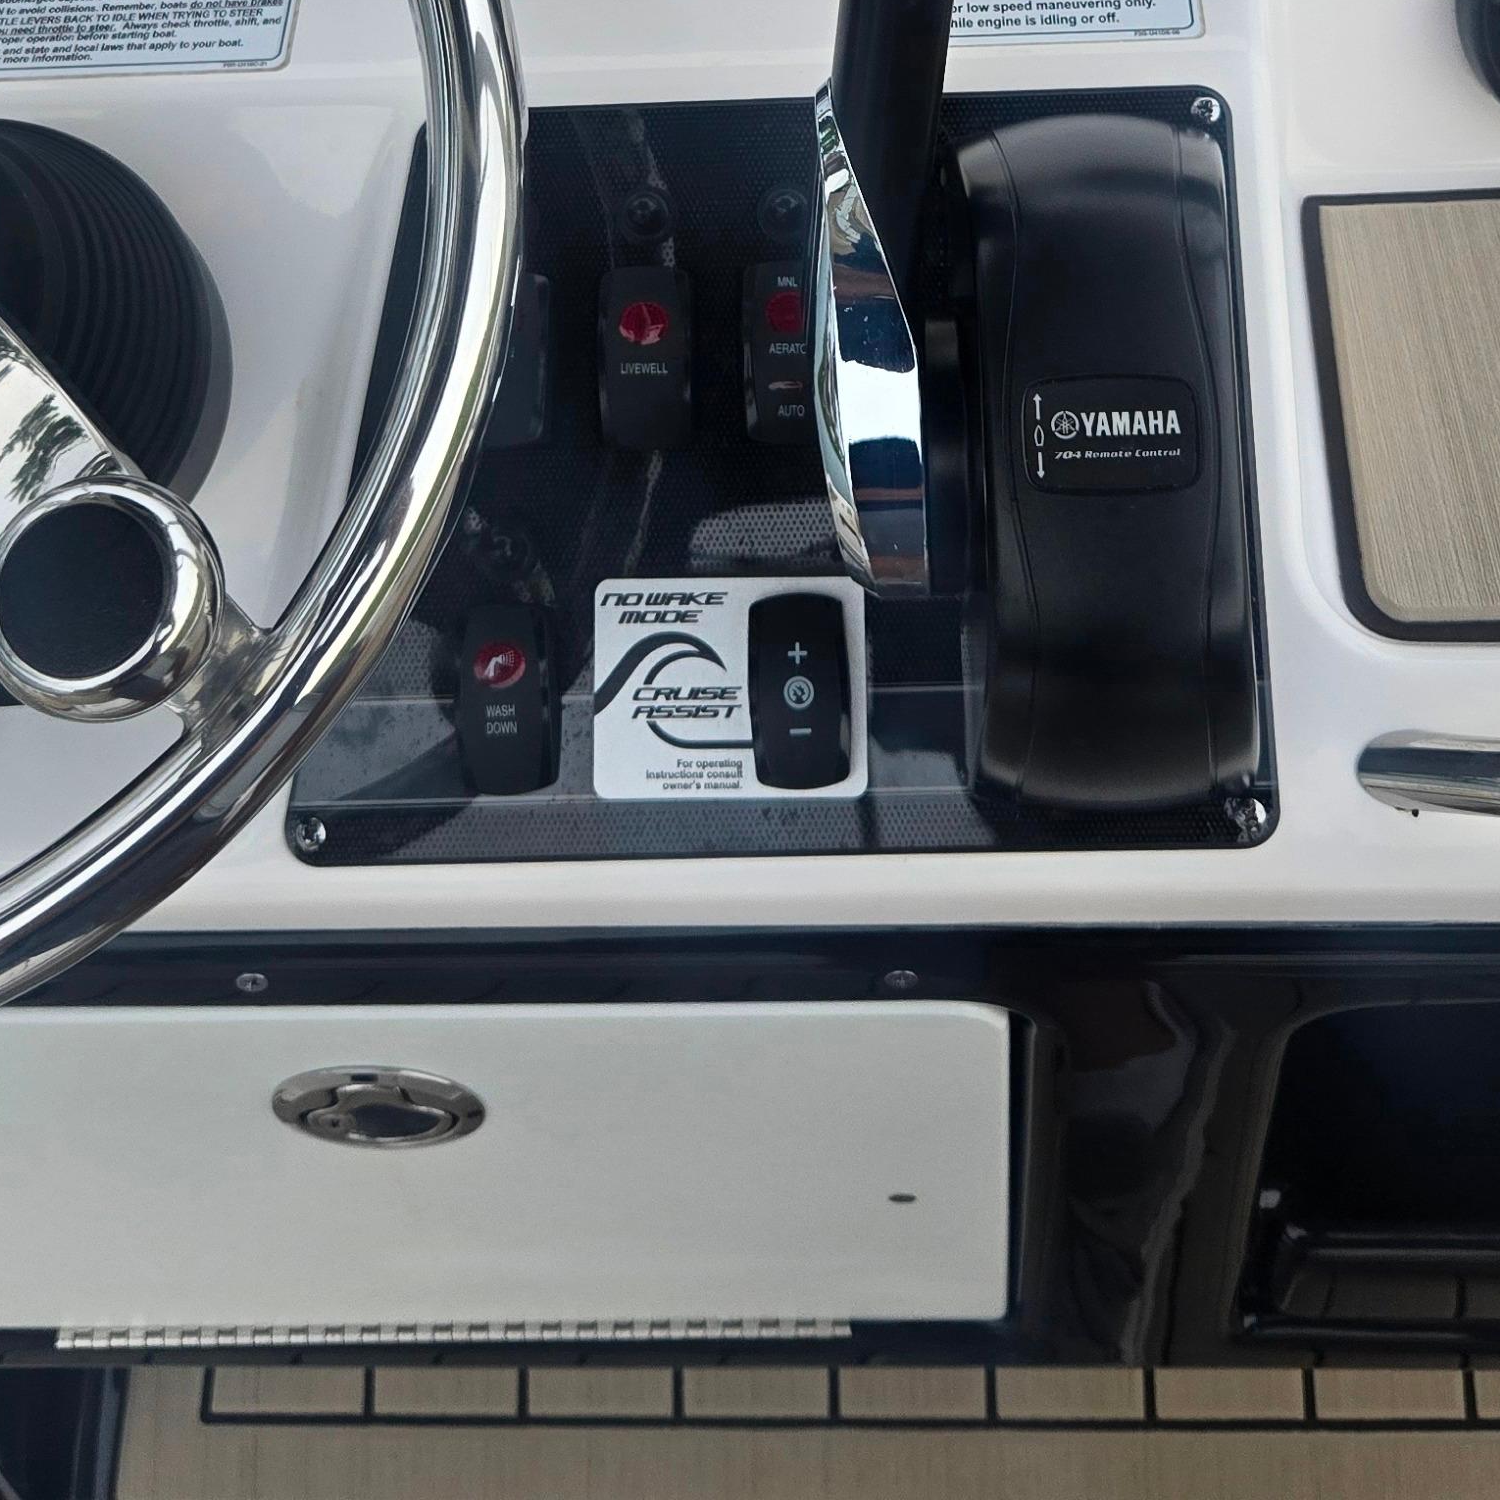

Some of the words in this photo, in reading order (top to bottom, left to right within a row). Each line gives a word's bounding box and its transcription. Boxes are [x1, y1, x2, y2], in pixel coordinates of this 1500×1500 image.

[967, 2, 989, 13] low
[993, 0, 1032, 13] speed
[20, 16, 61, 25] LEVERS
[64, 15, 92, 24] BACK
[112, 13, 137, 22] IDLE
[138, 12, 172, 20] WHEN
[172, 10, 210, 18] TRYING
[229, 8, 263, 17] STEER
[977, 16, 1021, 29] engine
[1026, 15, 1036, 26] is
[1040, 13, 1077, 27] idling
[1081, 15, 1094, 23] or
[1098, 12, 1120, 23] off.
[777, 276, 798, 288] MNL
[620, 363, 668, 374] LIVEWELL
[778, 404, 805, 416] AUTO
[1080, 410, 1181, 437] YAMAHA
[1054, 450, 1081, 459] 704
[1085, 450, 1132, 458] Remote
[1135, 448, 1180, 457] Control
[600, 592, 644, 607] NO
[645, 591, 728, 606] WAKE
[618, 610, 703, 624] MODE
[632, 686, 742, 701] CRUISE
[486, 704, 515, 717] WASH
[632, 704, 742, 719] ASSIST
[486, 721, 518, 734] DOWN
[677, 759, 693, 768] For
[663, 780, 701, 789] owner's
[704, 781, 743, 789] manual.
